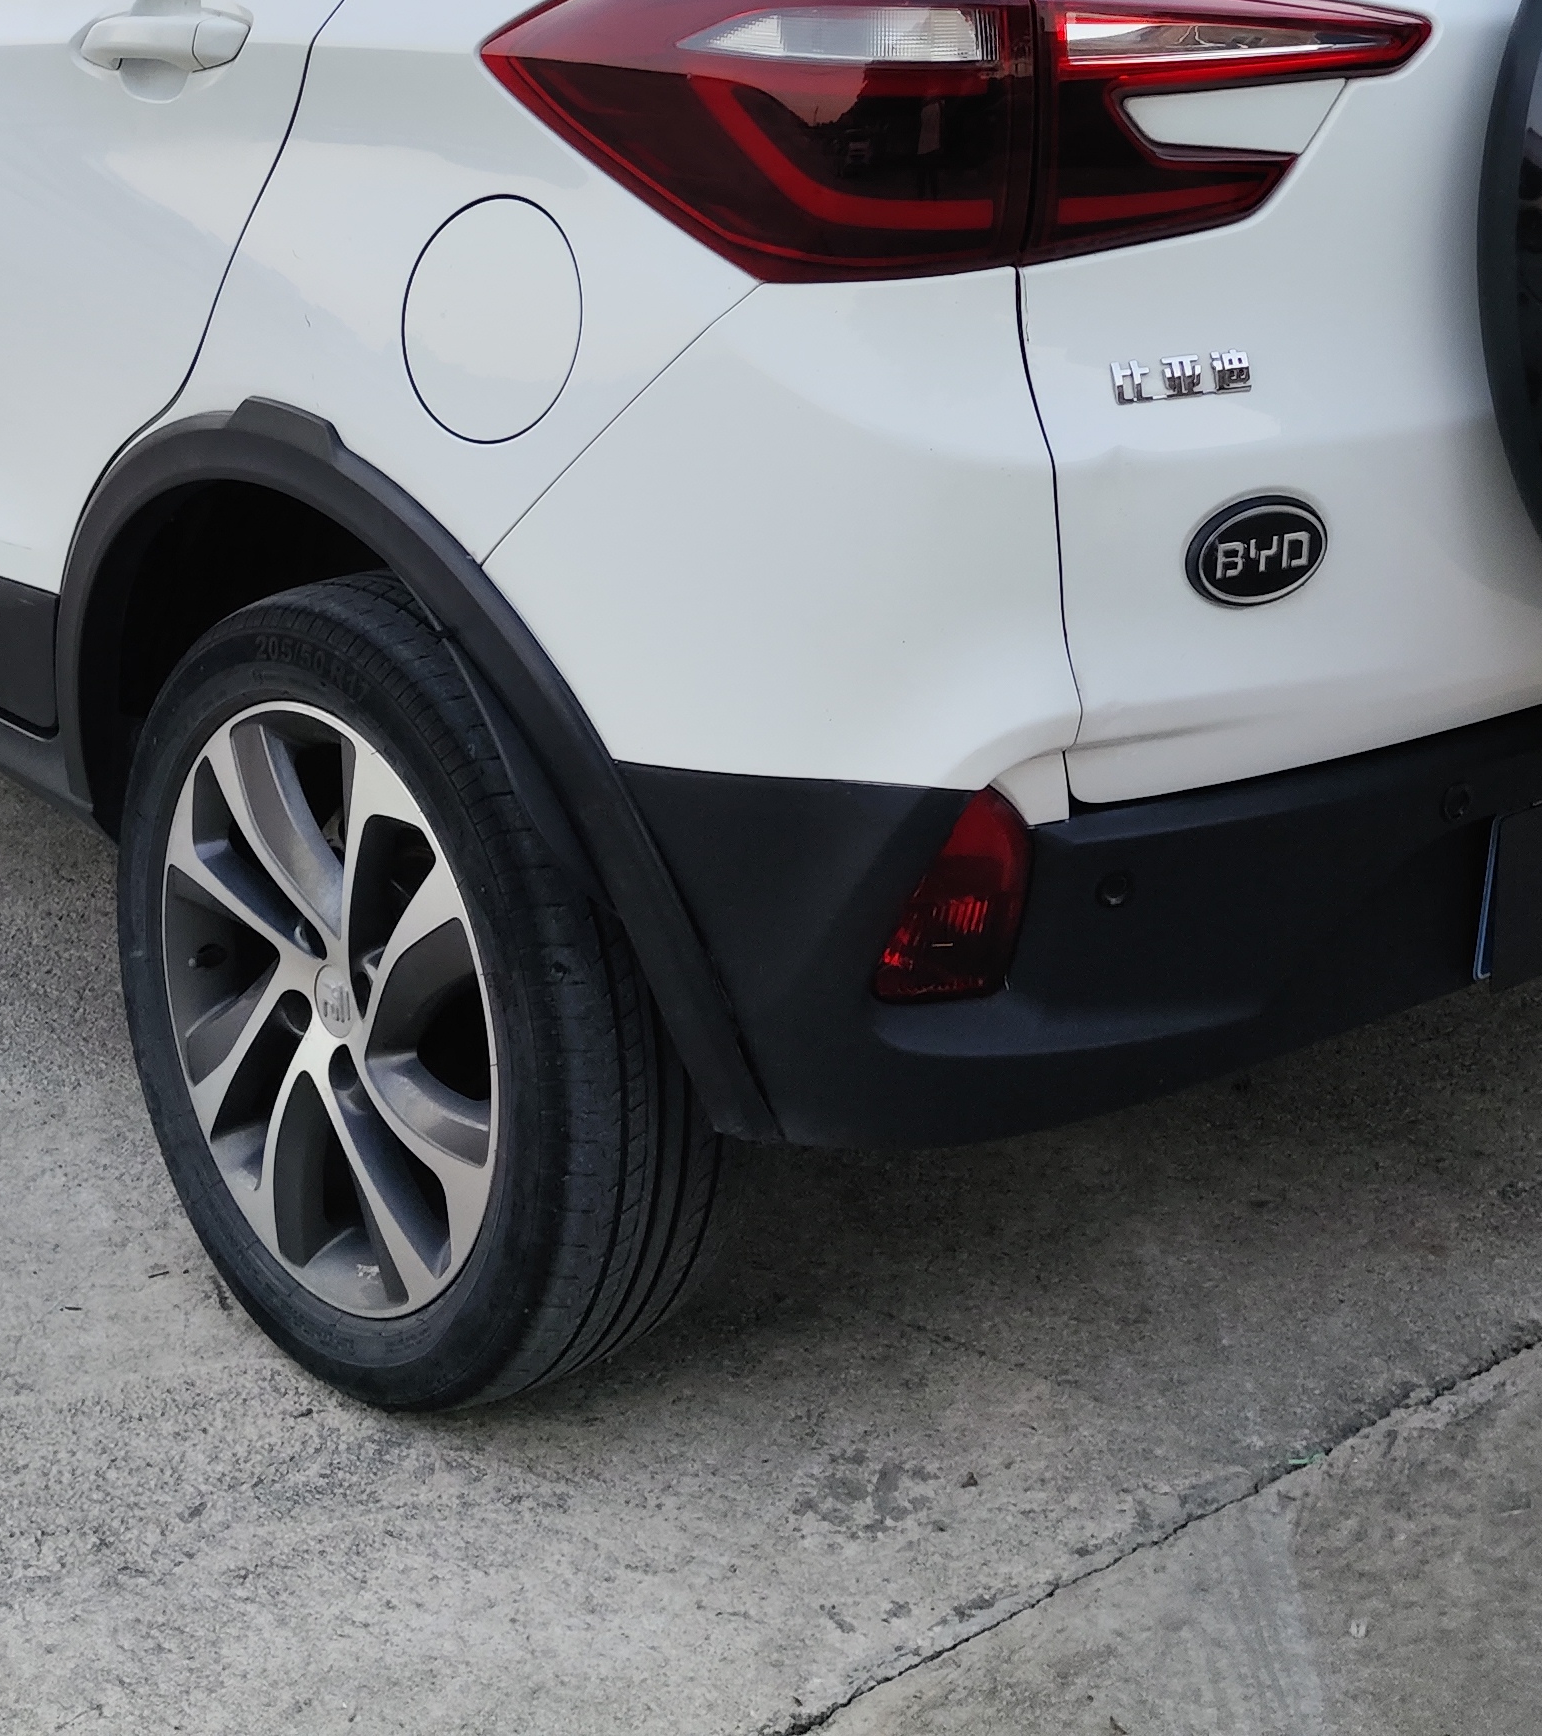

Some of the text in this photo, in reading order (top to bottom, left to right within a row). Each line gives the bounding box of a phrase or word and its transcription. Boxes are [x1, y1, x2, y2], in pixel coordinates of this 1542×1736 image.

[1110, 348, 1253, 406] 比亚迪
[1215, 531, 1312, 581] BYD
[254, 635, 326, 675] 205/50
